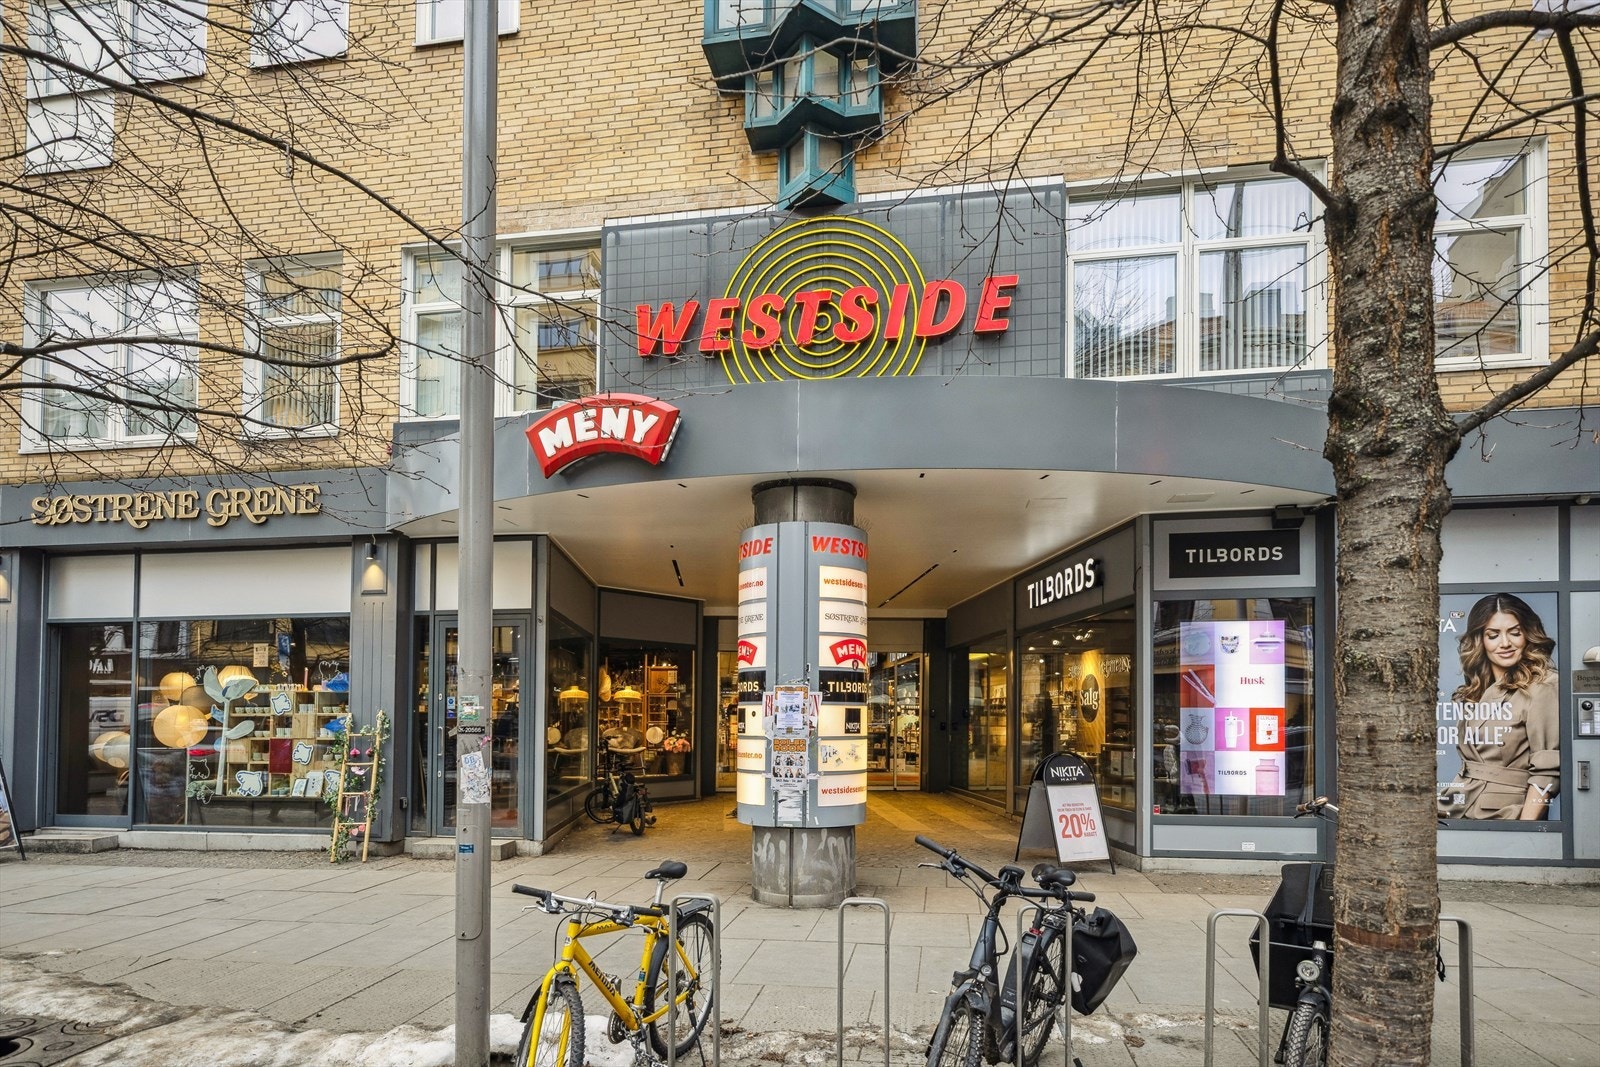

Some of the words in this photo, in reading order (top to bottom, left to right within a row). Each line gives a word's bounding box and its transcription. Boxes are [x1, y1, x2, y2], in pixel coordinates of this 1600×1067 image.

[635, 274, 1020, 357] WESTSIDE
[538, 407, 659, 458] MENY
[31, 490, 200, 529] SØSTRENE
[205, 484, 322, 527] GRENE
[1185, 546, 1283, 563] TILBORDS
[1027, 557, 1095, 608] TILBORDS
[827, 681, 867, 694] TILBORDS
[1240, 676, 1265, 685] Husk
[1050, 765, 1085, 778] NIKITA
[1058, 812, 1096, 839] 20%
